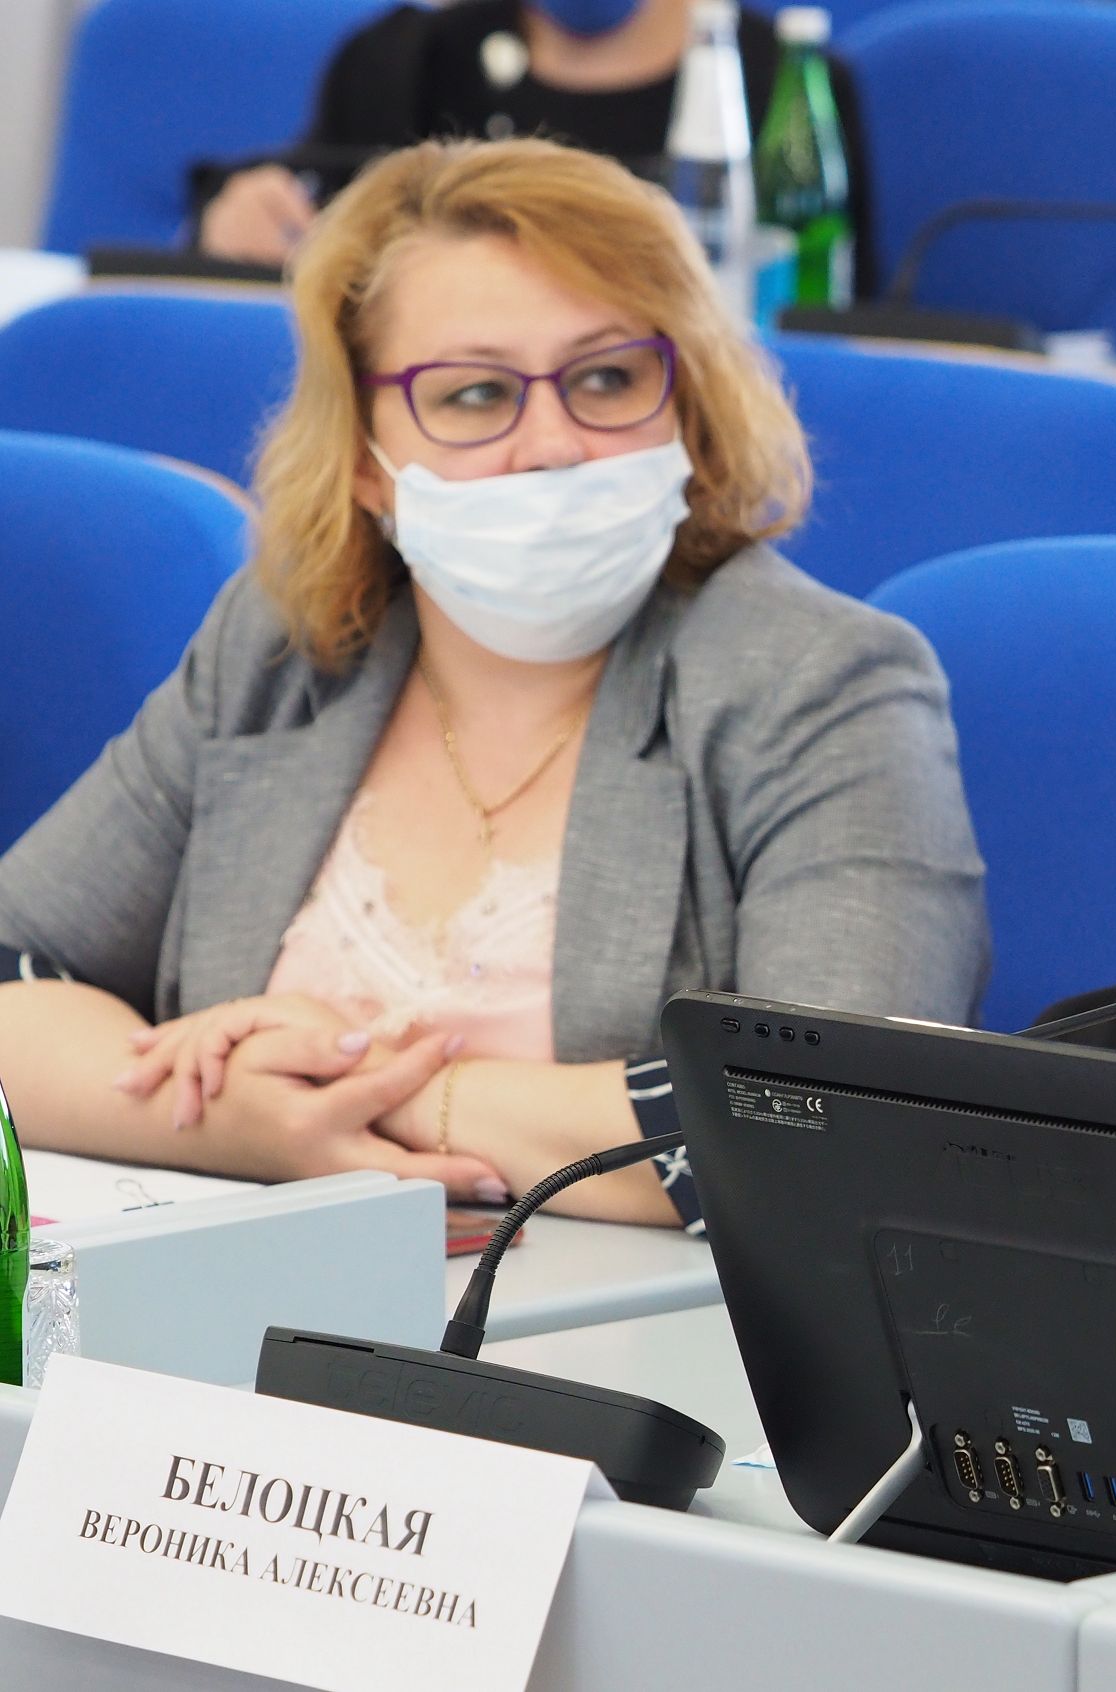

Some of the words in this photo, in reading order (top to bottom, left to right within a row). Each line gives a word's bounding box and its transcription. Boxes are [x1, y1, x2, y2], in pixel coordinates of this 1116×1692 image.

[161, 1455, 436, 1556] БЕЛОЦКАЯ
[78, 1509, 250, 1576] ВЕРОНИКА
[259, 1553, 477, 1629] АЛЕКСЕЕВНА
